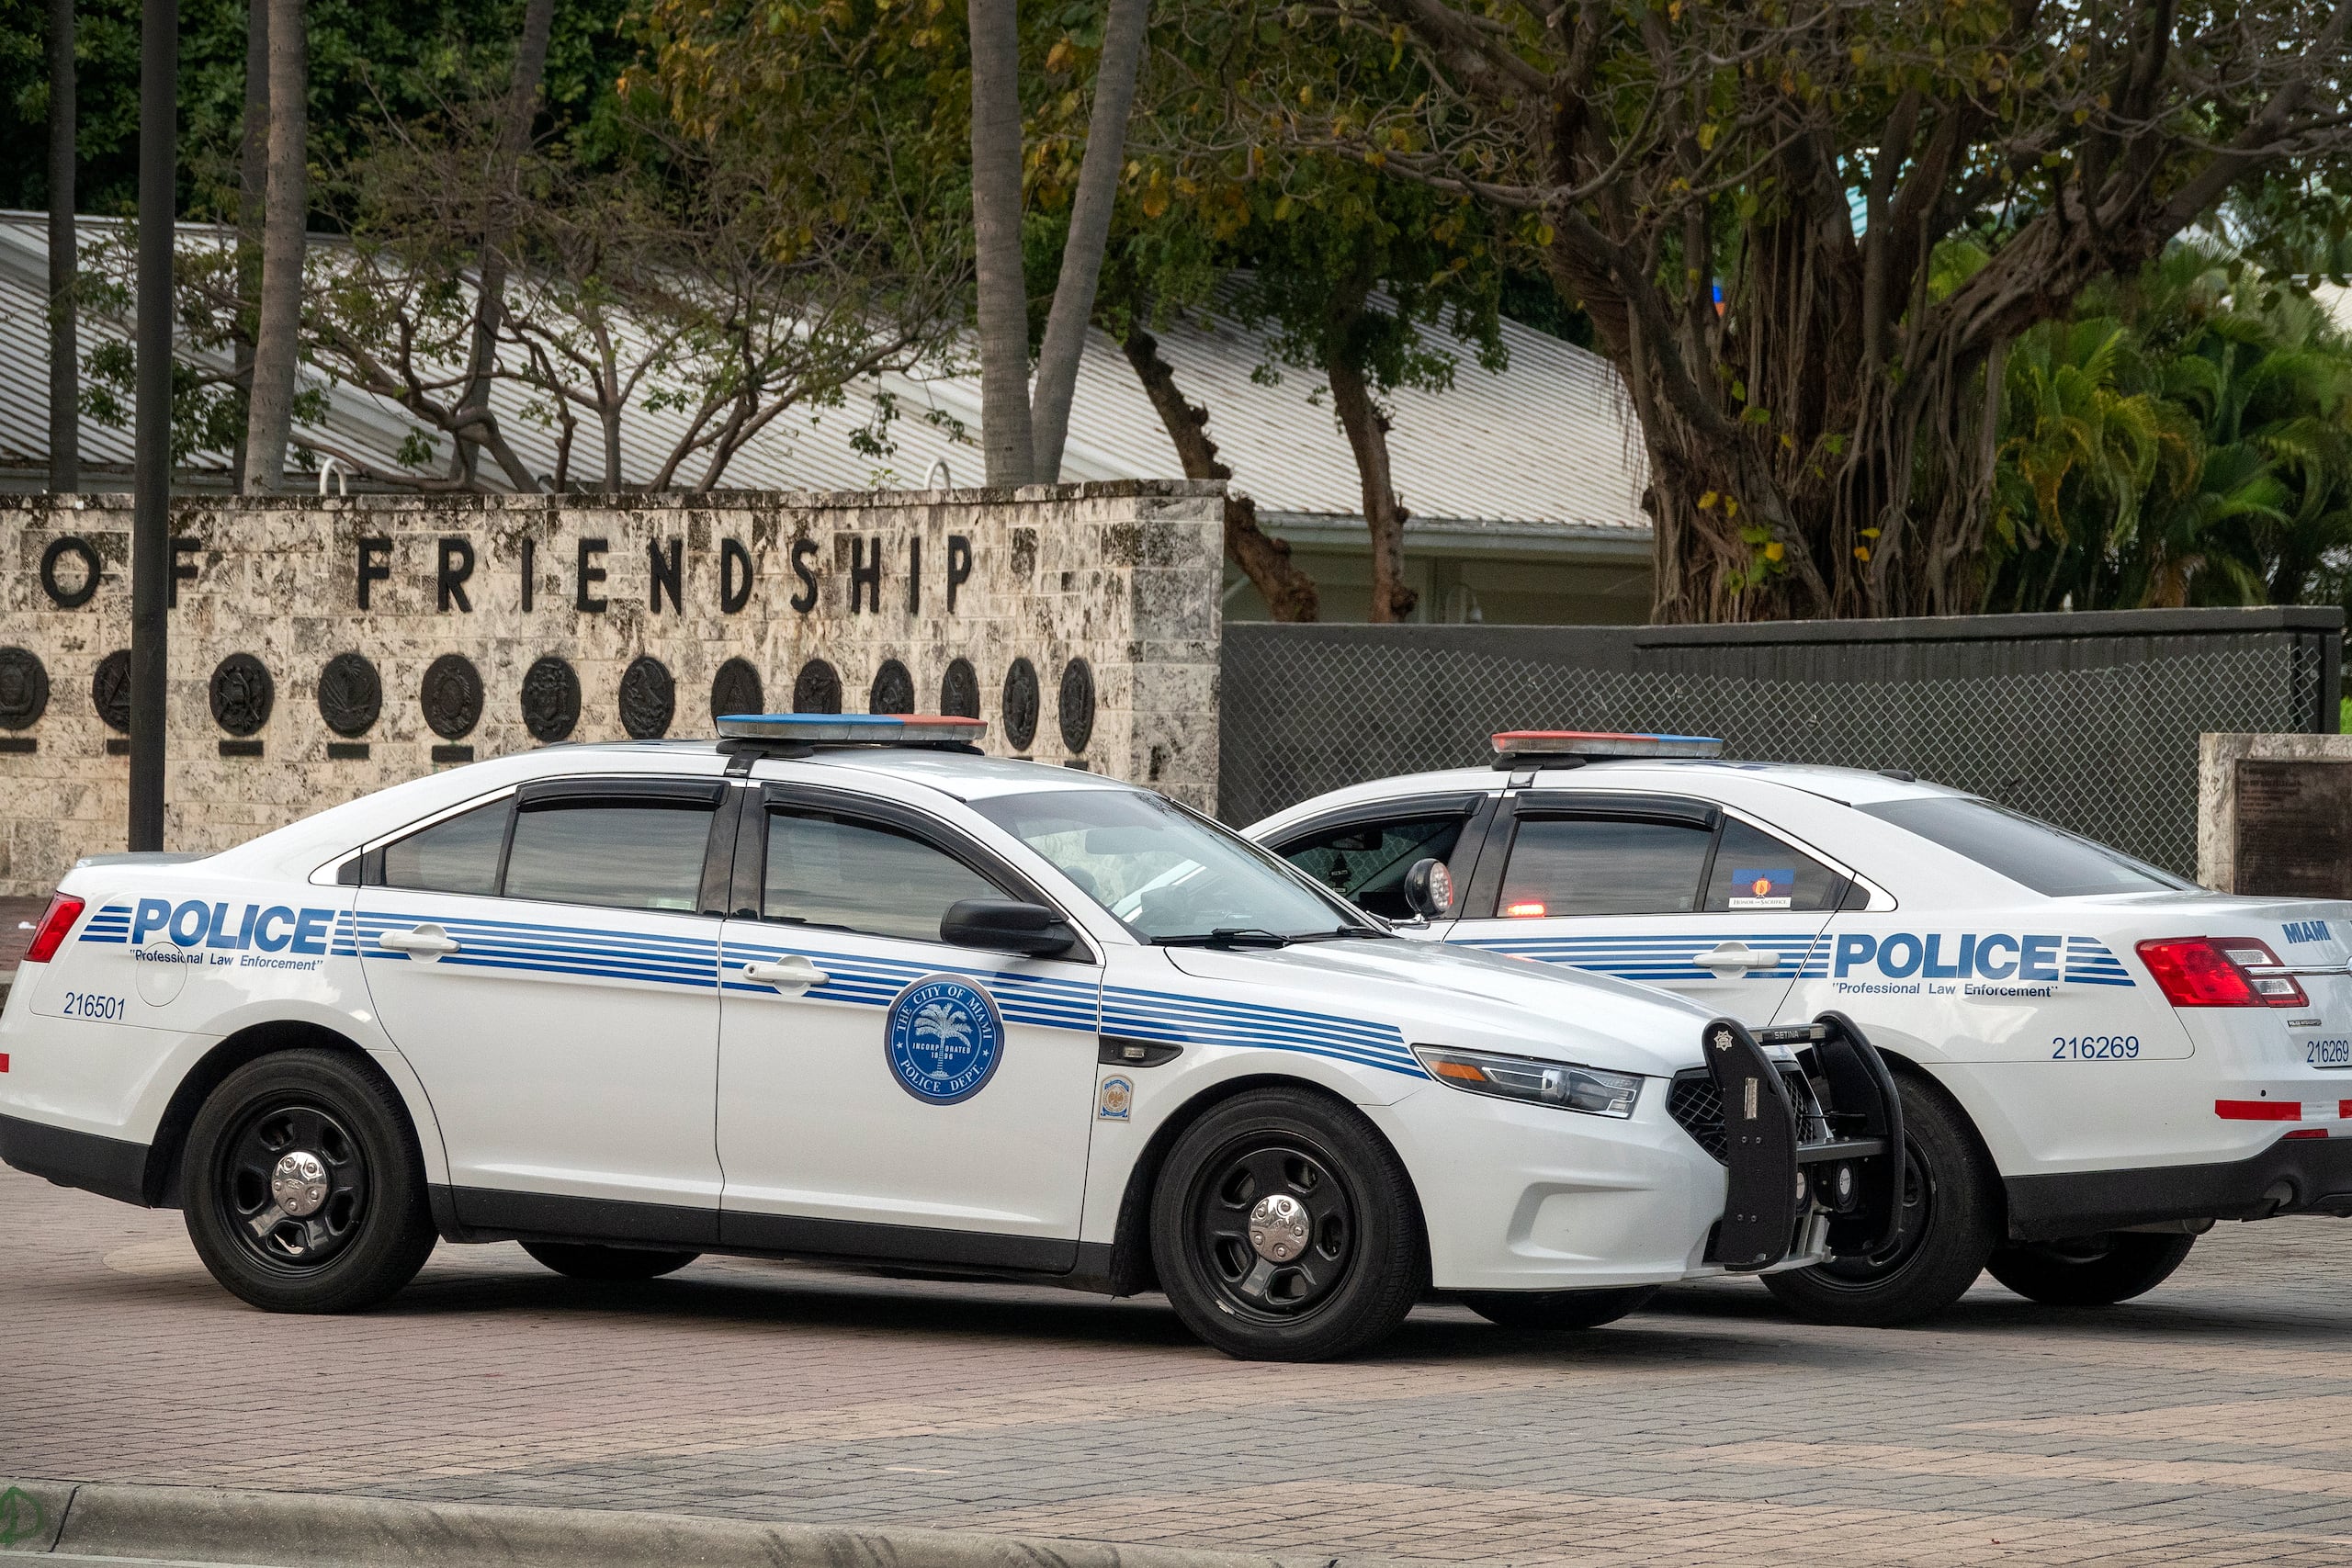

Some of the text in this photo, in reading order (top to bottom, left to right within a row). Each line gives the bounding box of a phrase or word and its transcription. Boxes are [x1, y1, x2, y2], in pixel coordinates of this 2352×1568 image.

[40, 536, 972, 615] OF FRIENDSHIP
[131, 897, 336, 955] POLICE
[2281, 920, 2332, 944] MIAMI
[209, 953, 234, 964] Law
[1834, 932, 2063, 981] POLICE
[1928, 984, 1956, 995] Law
[63, 992, 125, 1021] 216501
[897, 986, 993, 1040] THE CITY OF MIAMI
[1774, 1030, 1799, 1040] SETINA
[2052, 1036, 2139, 1059] 216269
[2307, 1040, 2349, 1063] 216269
[900, 1059, 984, 1092] POLICE DEPT.
